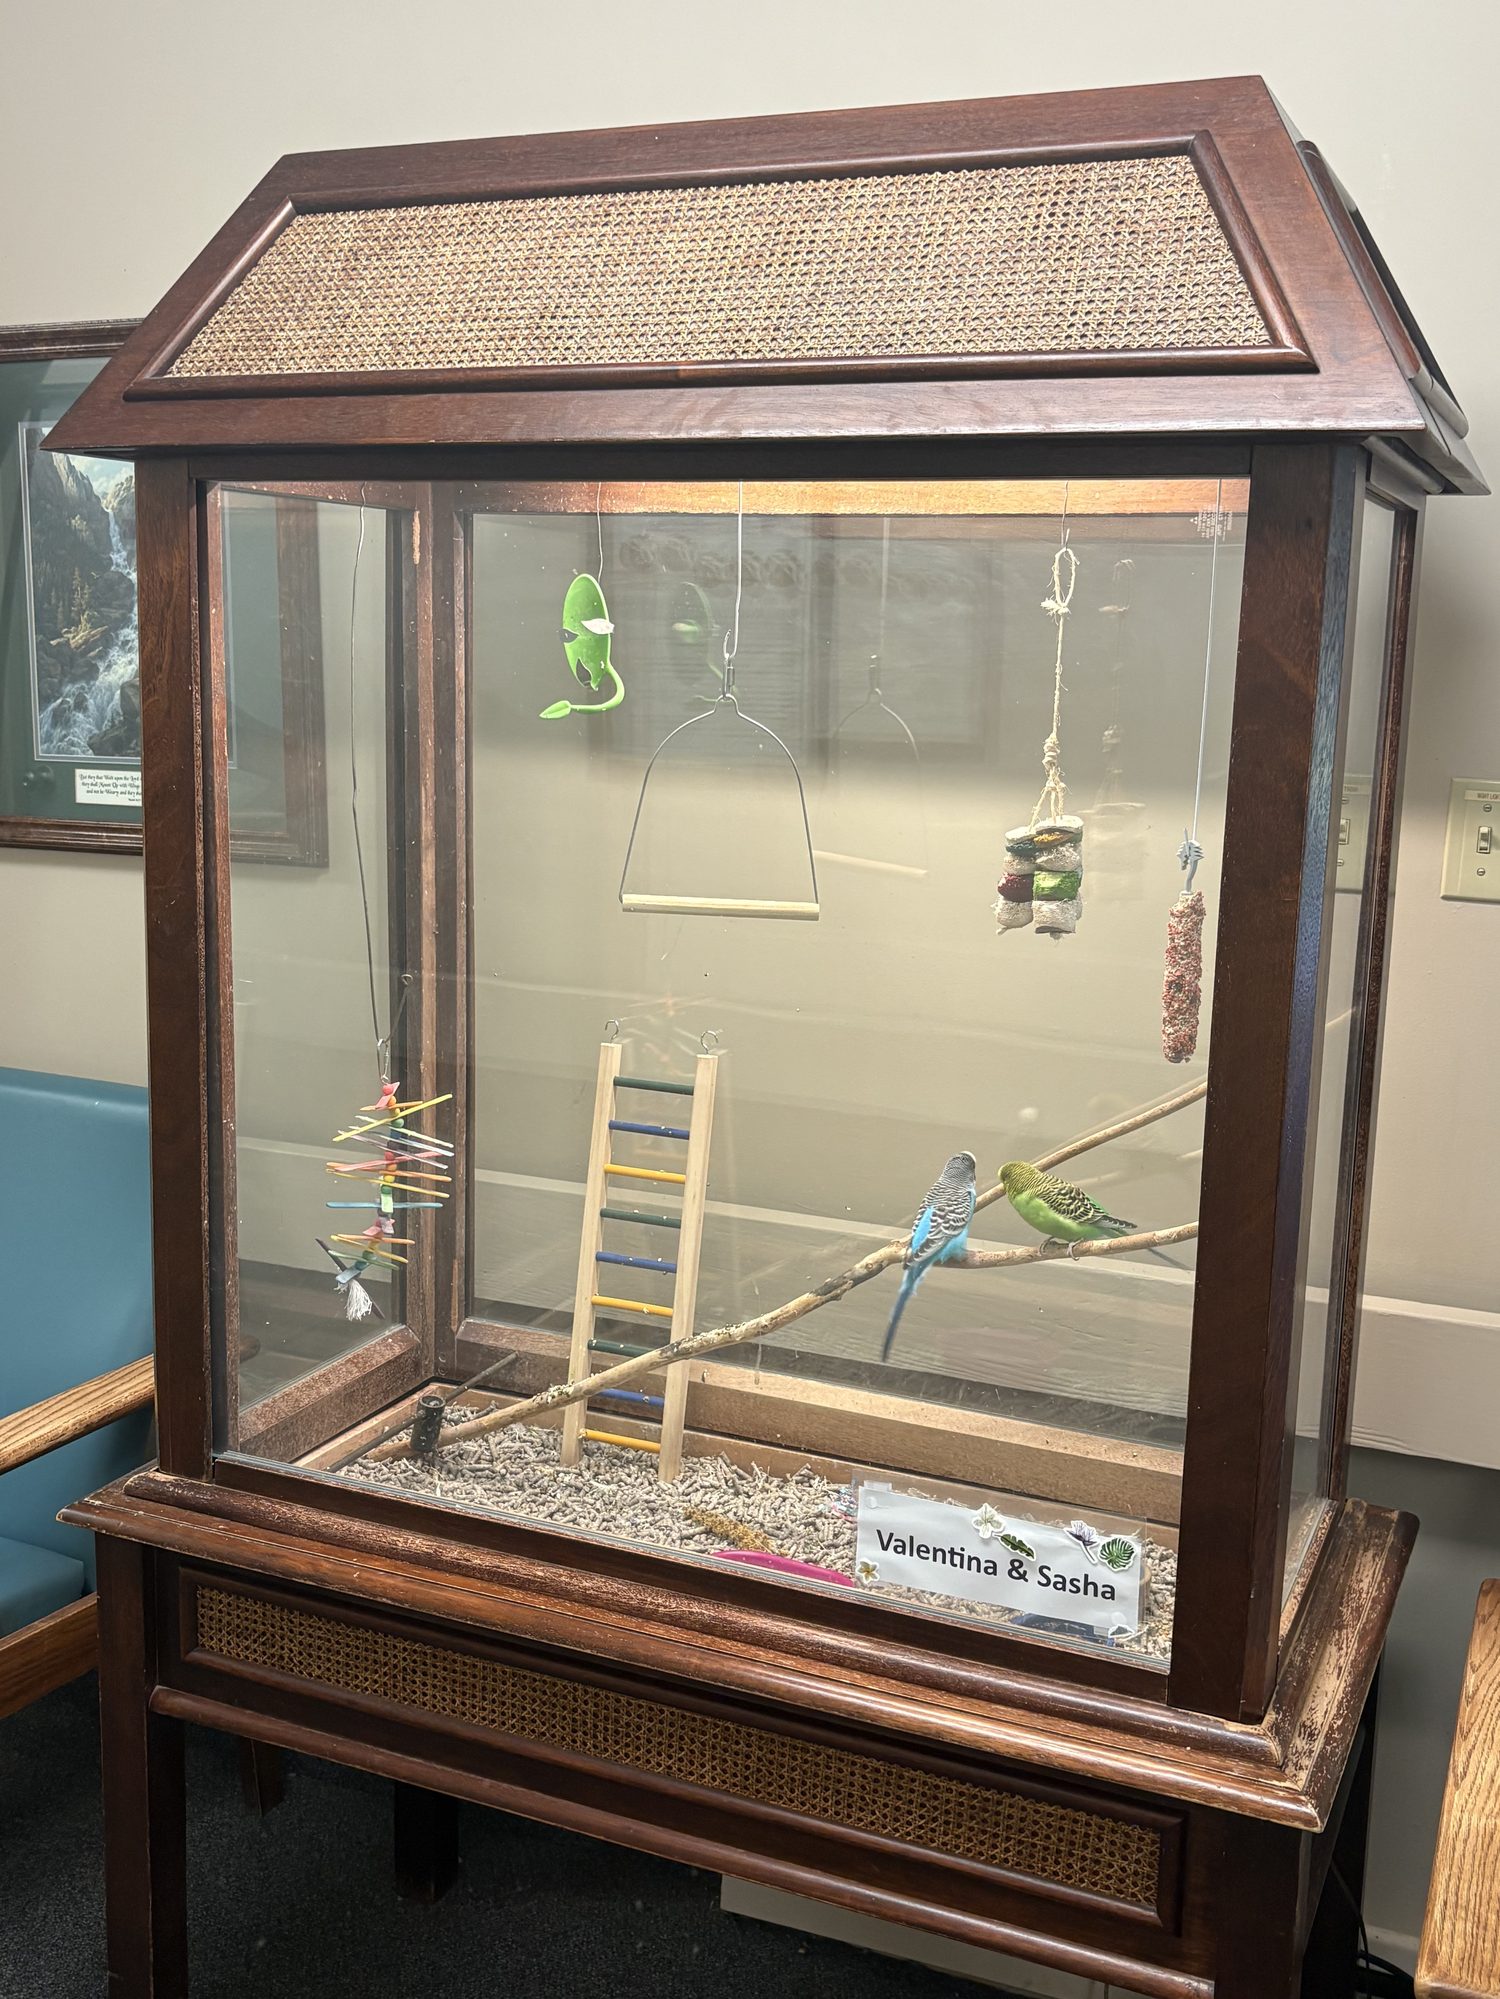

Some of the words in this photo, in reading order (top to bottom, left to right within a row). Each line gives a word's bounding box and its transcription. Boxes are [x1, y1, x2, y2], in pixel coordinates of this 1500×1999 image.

[877, 1529, 998, 1577] Valentina
[1007, 1558, 1029, 1583] &
[1037, 1565, 1116, 1601] Sasha
